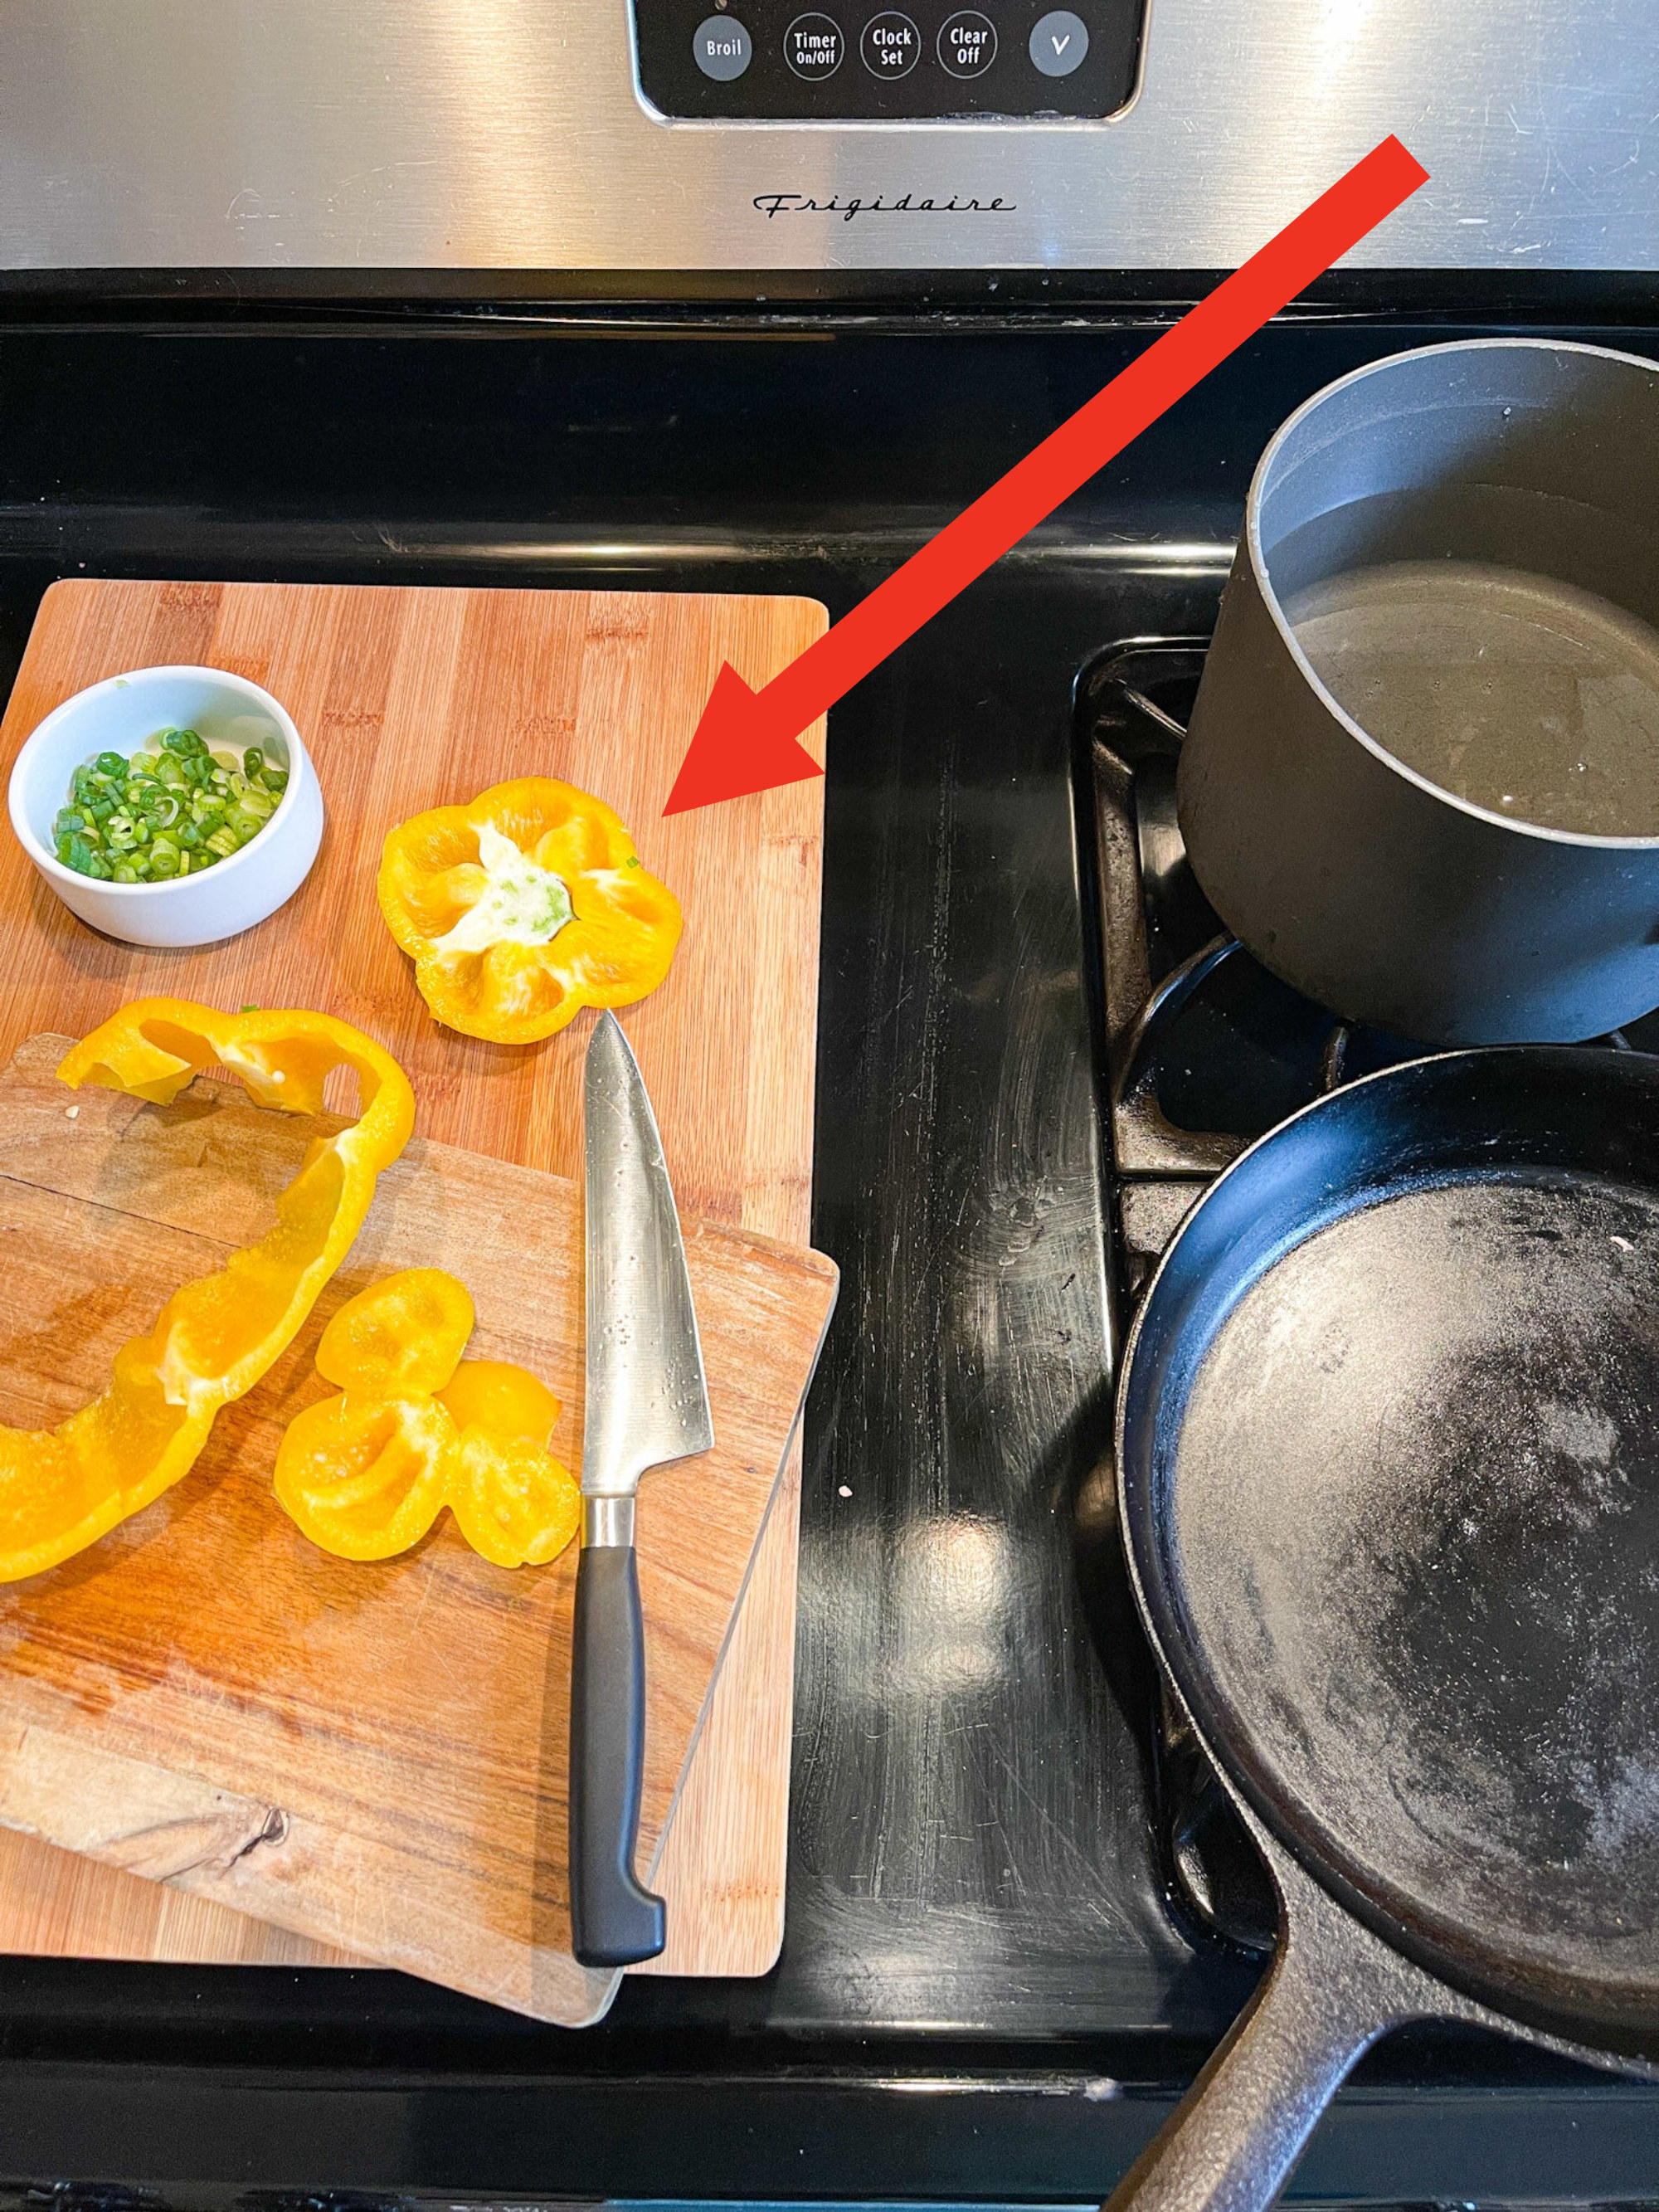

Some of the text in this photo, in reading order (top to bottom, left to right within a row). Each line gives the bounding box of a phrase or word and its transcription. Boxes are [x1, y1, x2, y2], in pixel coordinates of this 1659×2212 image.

[794, 32, 837, 48] Timer
[873, 27, 912, 46] Clock
[950, 27, 988, 45] Clear
[707, 38, 742, 56] Broil
[957, 46, 980, 64] Off
[796, 50, 835, 66] On/Off
[881, 49, 903, 66] Set
[753, 193, 1017, 222] Frigidaire
